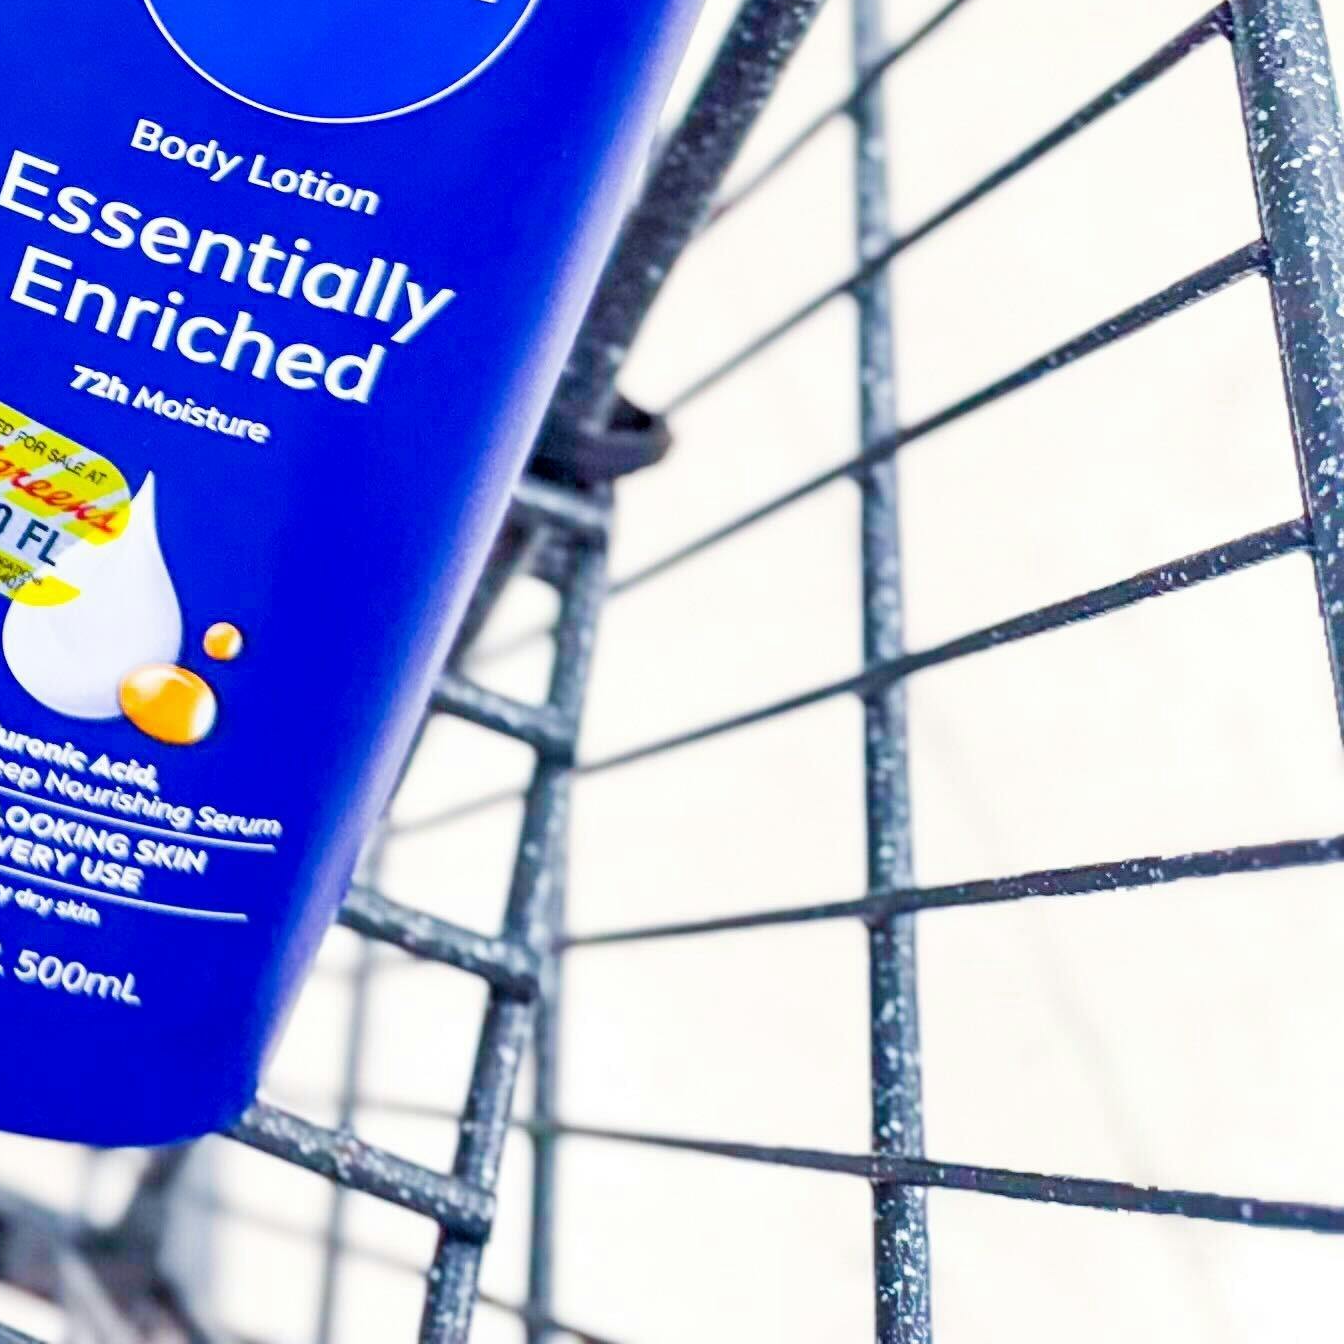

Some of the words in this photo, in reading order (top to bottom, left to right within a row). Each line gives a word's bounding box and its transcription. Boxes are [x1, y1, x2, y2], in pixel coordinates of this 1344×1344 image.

[130, 118, 243, 182] Body
[248, 154, 382, 217] Lotion
[10, 245, 387, 405] Enriched
[69, 364, 130, 405] 72h
[132, 384, 272, 445] Moisture
[15, 430, 47, 457] FOR
[47, 448, 86, 476] SALE
[84, 469, 108, 486] AT
[16, 518, 60, 567] FL
[43, 771, 195, 829] Nourishing
[195, 805, 283, 839] Serum
[81, 858, 145, 895] USE
[133, 838, 209, 875] SKIN
[14, 885, 56, 922] dry
[54, 894, 102, 927] skin
[14, 948, 144, 1008] 500mL
